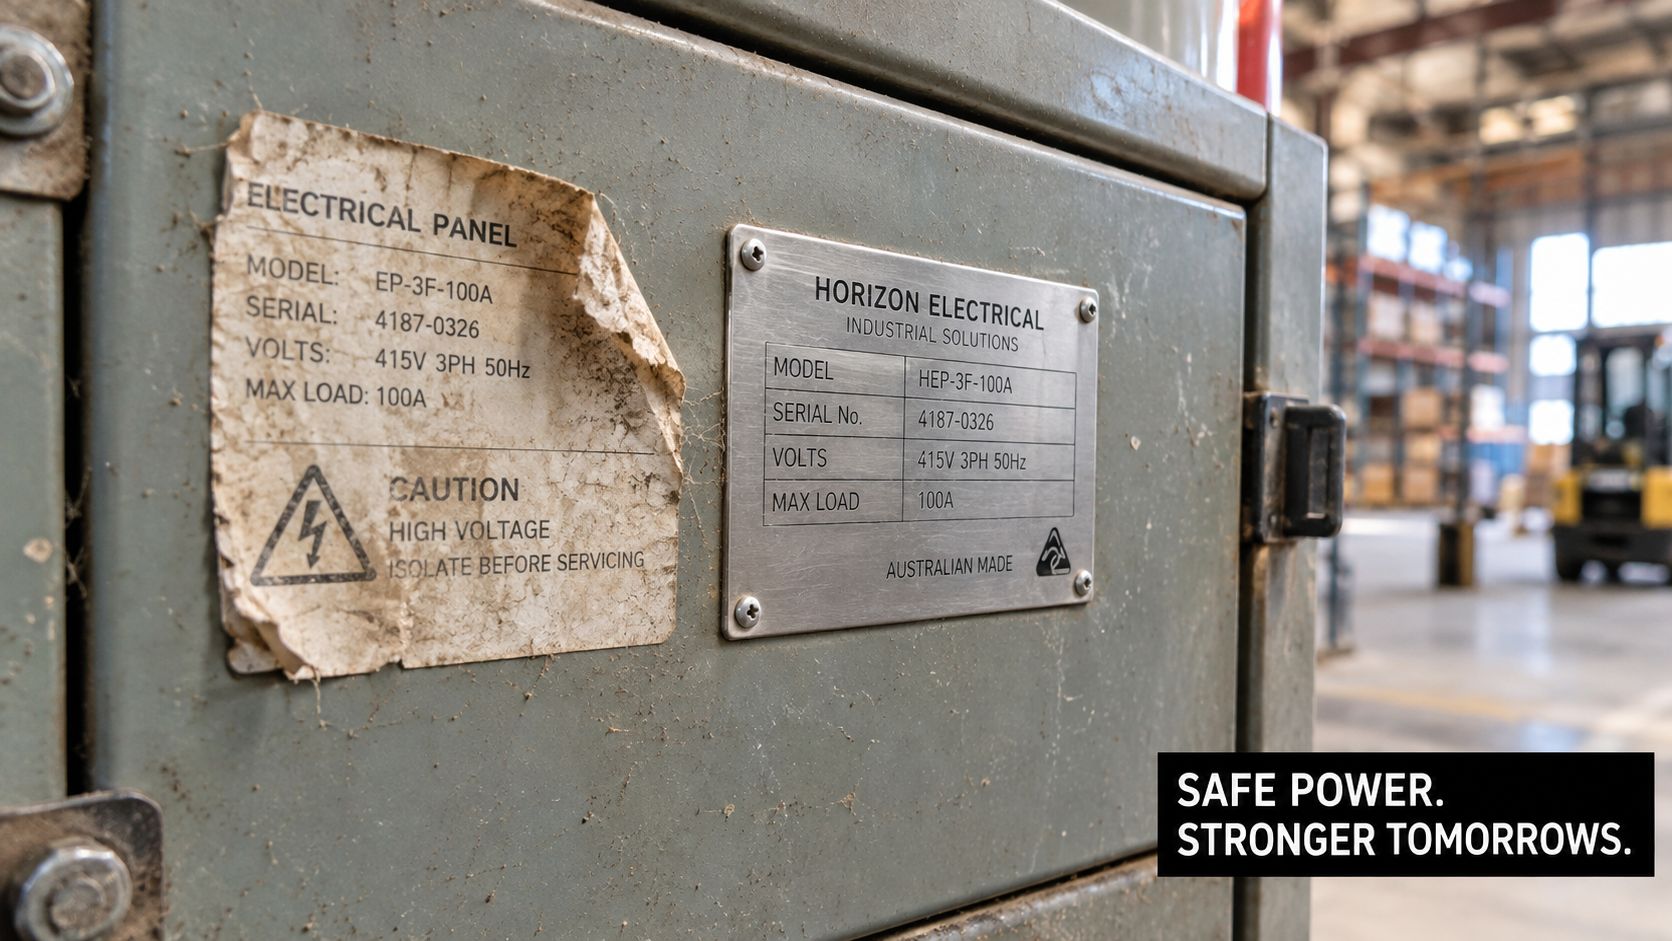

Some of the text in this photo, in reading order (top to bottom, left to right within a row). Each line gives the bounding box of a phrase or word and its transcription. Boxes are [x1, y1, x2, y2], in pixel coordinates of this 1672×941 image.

[247, 182, 517, 248] ELECTRICAL PANEL
[247, 254, 492, 304] MODEL: EP-3F-100A
[247, 296, 479, 338] SERIAL: 4187-0326
[815, 276, 1044, 330] HORIZON ELECTRICAL
[847, 316, 1019, 352] INDUSTRIAL SOLUTIONS
[247, 337, 530, 379] VOLTS: 415V 3PH 50Hz
[774, 357, 1012, 394] MODEL HEP-3F-100A
[246, 378, 427, 408] MAX LOAD: 100A
[773, 402, 994, 431] SERIAL No. 4187-0326
[772, 448, 1026, 470] VOLTS 415V 3PH 50Hz
[389, 477, 519, 502] CAUTION
[772, 491, 954, 512] MAX LOAD 100A
[390, 520, 550, 541] HIGH VOLTAGE
[389, 551, 645, 578] ISOLATE BEFORE SERVICING
[886, 555, 1013, 579] AUSTRALIAN MADE
